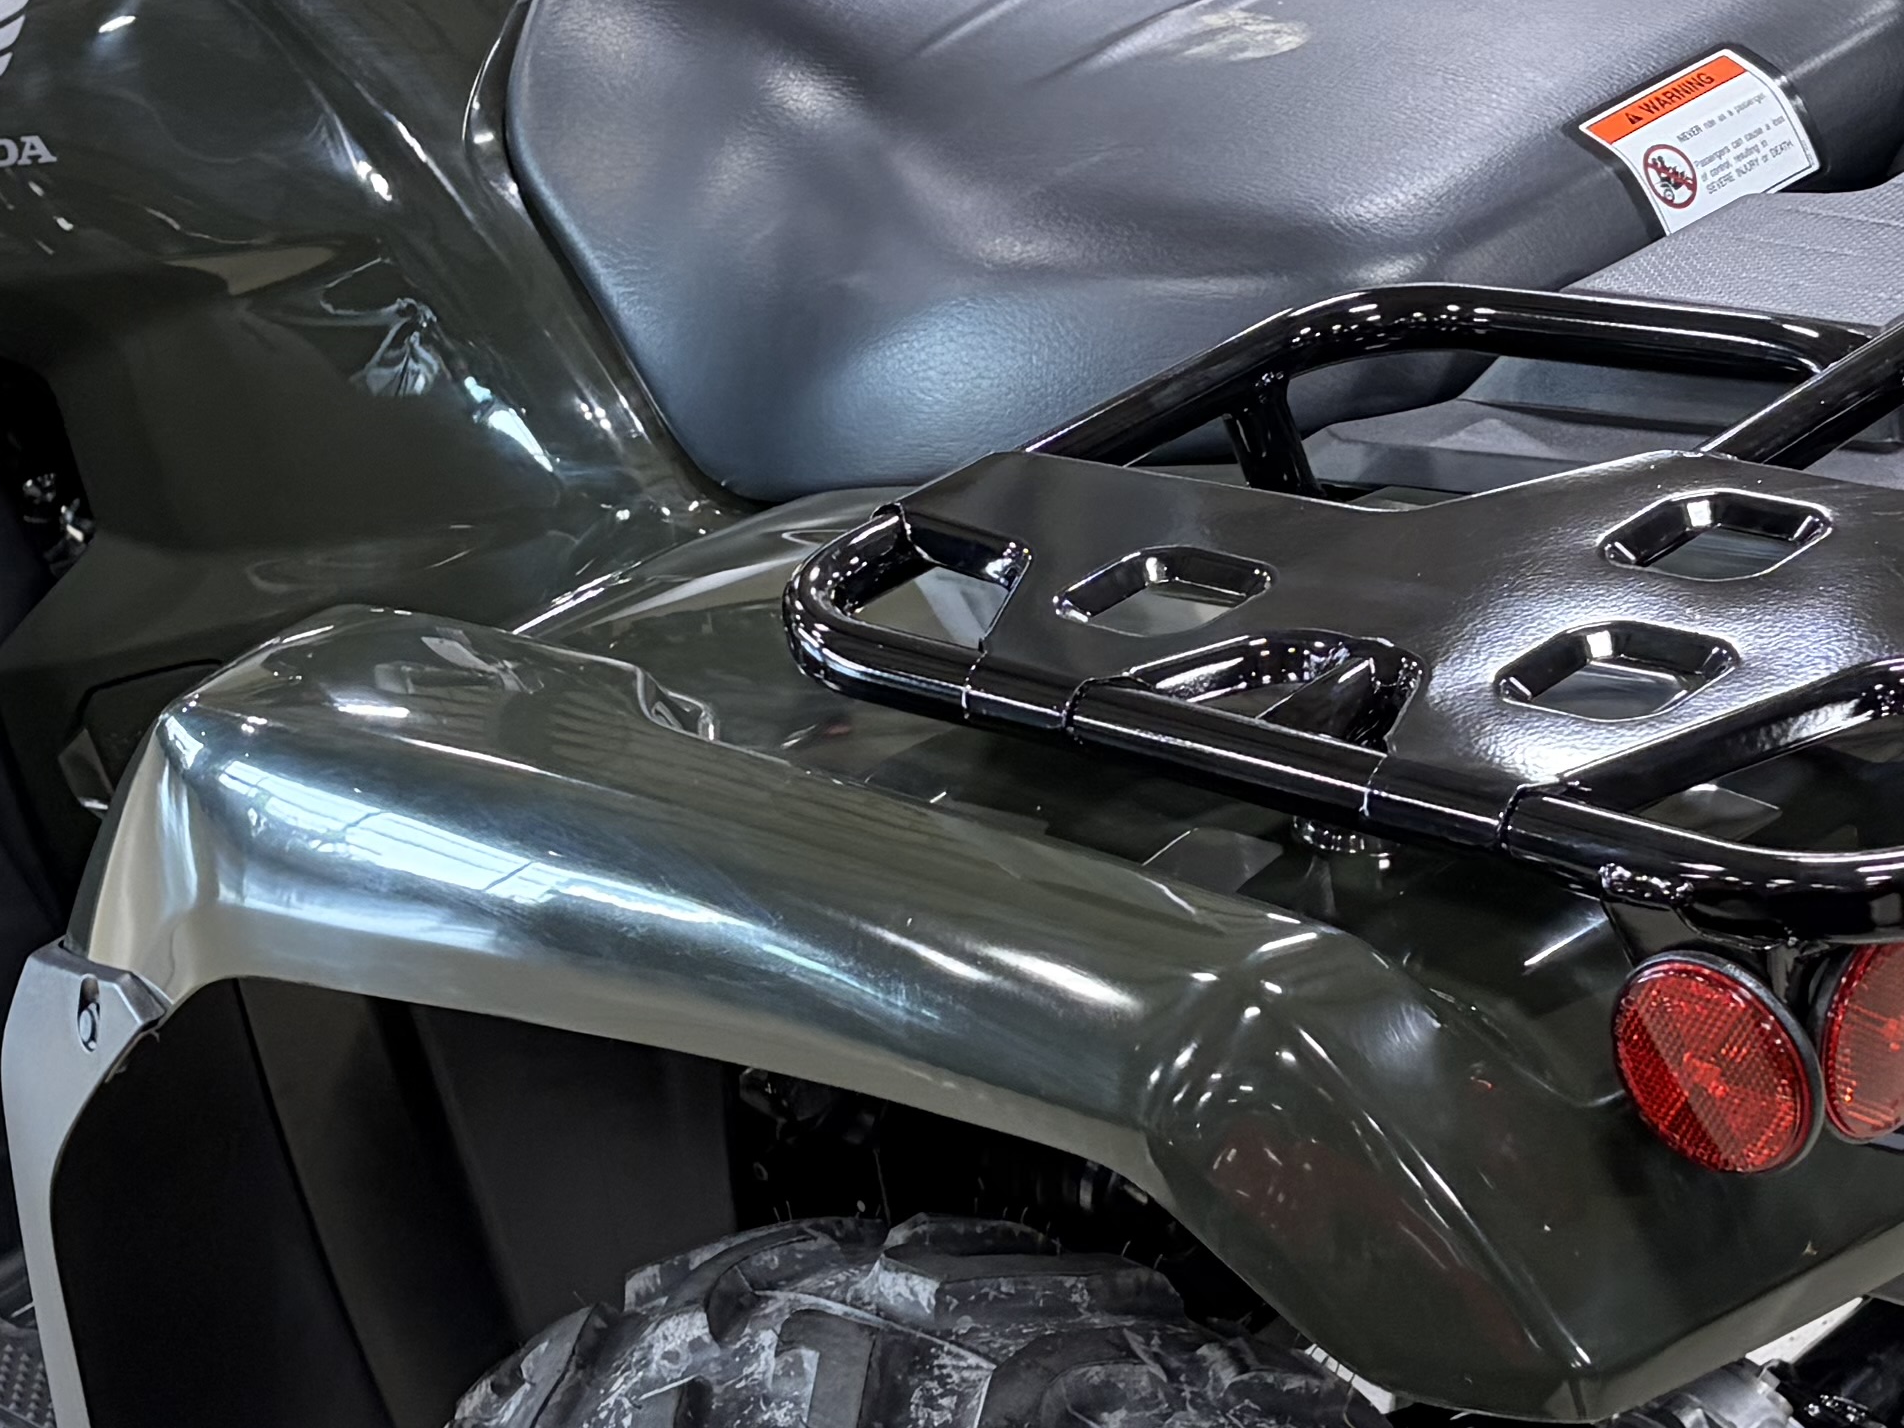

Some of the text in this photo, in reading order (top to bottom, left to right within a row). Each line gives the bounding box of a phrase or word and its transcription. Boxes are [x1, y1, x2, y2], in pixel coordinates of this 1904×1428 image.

[1638, 72, 1715, 115] WARNING
[1676, 125, 1703, 142] NEVER
[1706, 171, 1736, 194] SEVERE
[1735, 157, 1760, 177] INJURY
